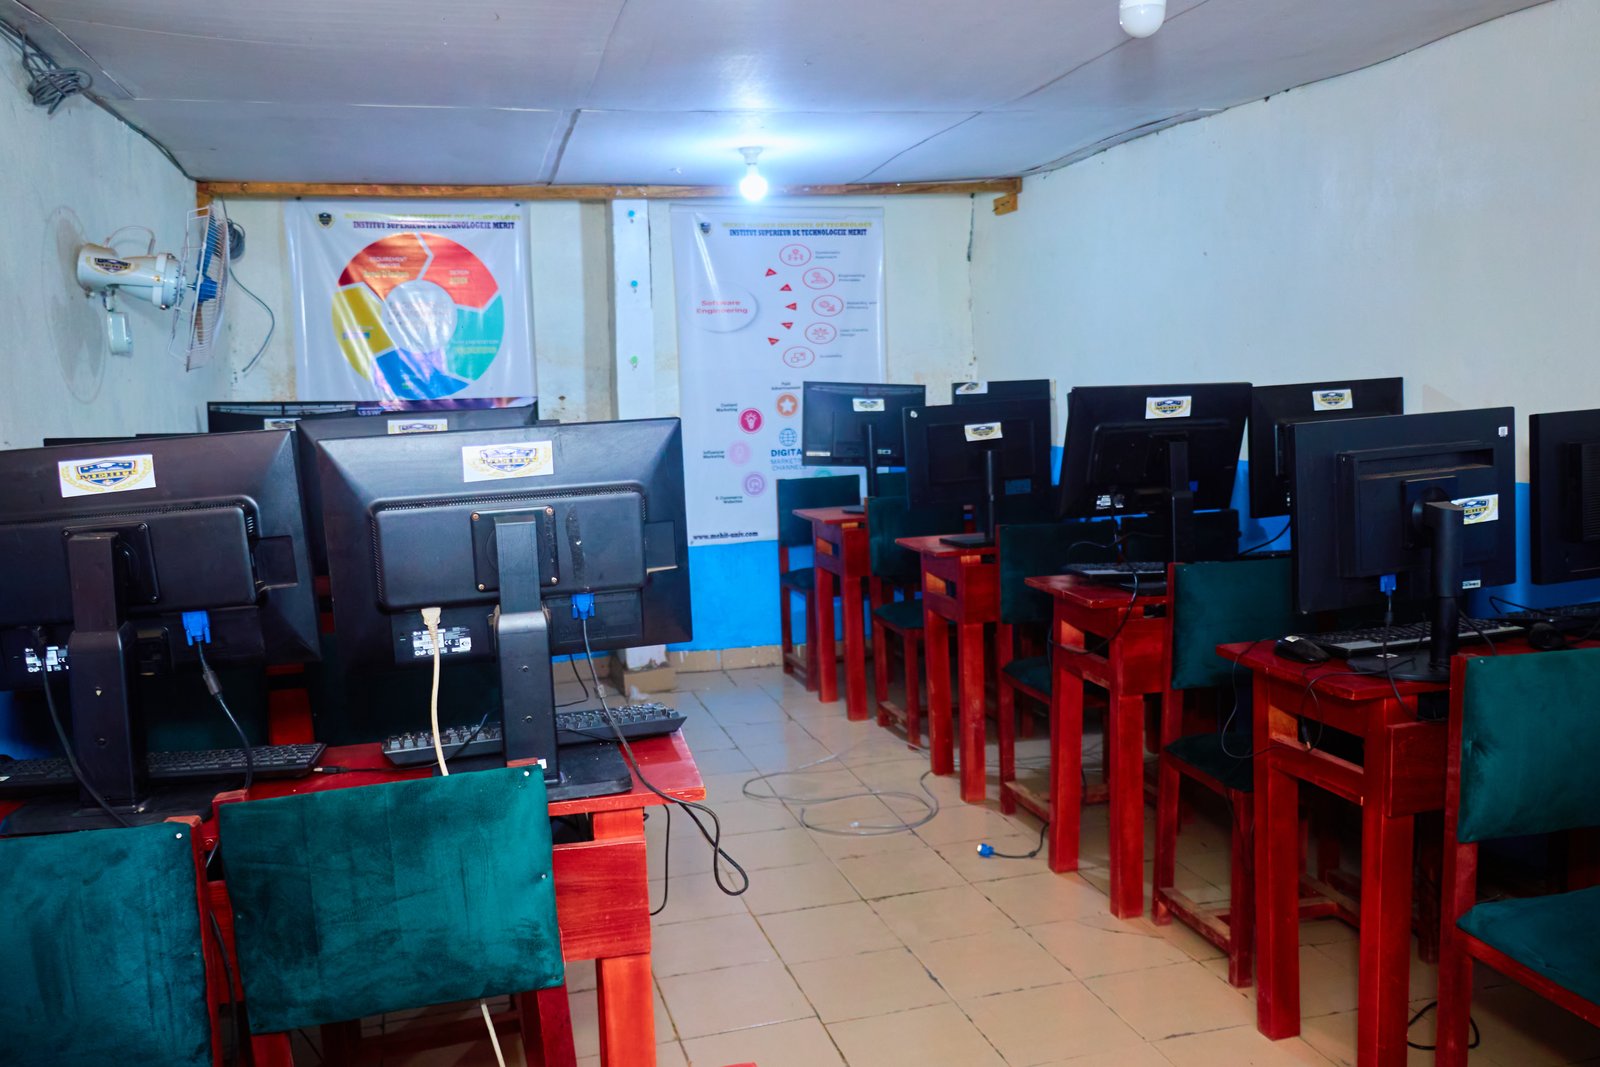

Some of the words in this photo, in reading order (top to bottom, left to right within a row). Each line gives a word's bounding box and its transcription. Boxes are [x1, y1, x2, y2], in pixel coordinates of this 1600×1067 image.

[353, 221, 385, 229] INSTITUT
[493, 221, 515, 229] MERIT
[848, 228, 867, 236] MERIT
[770, 449, 802, 457] DIGITA
